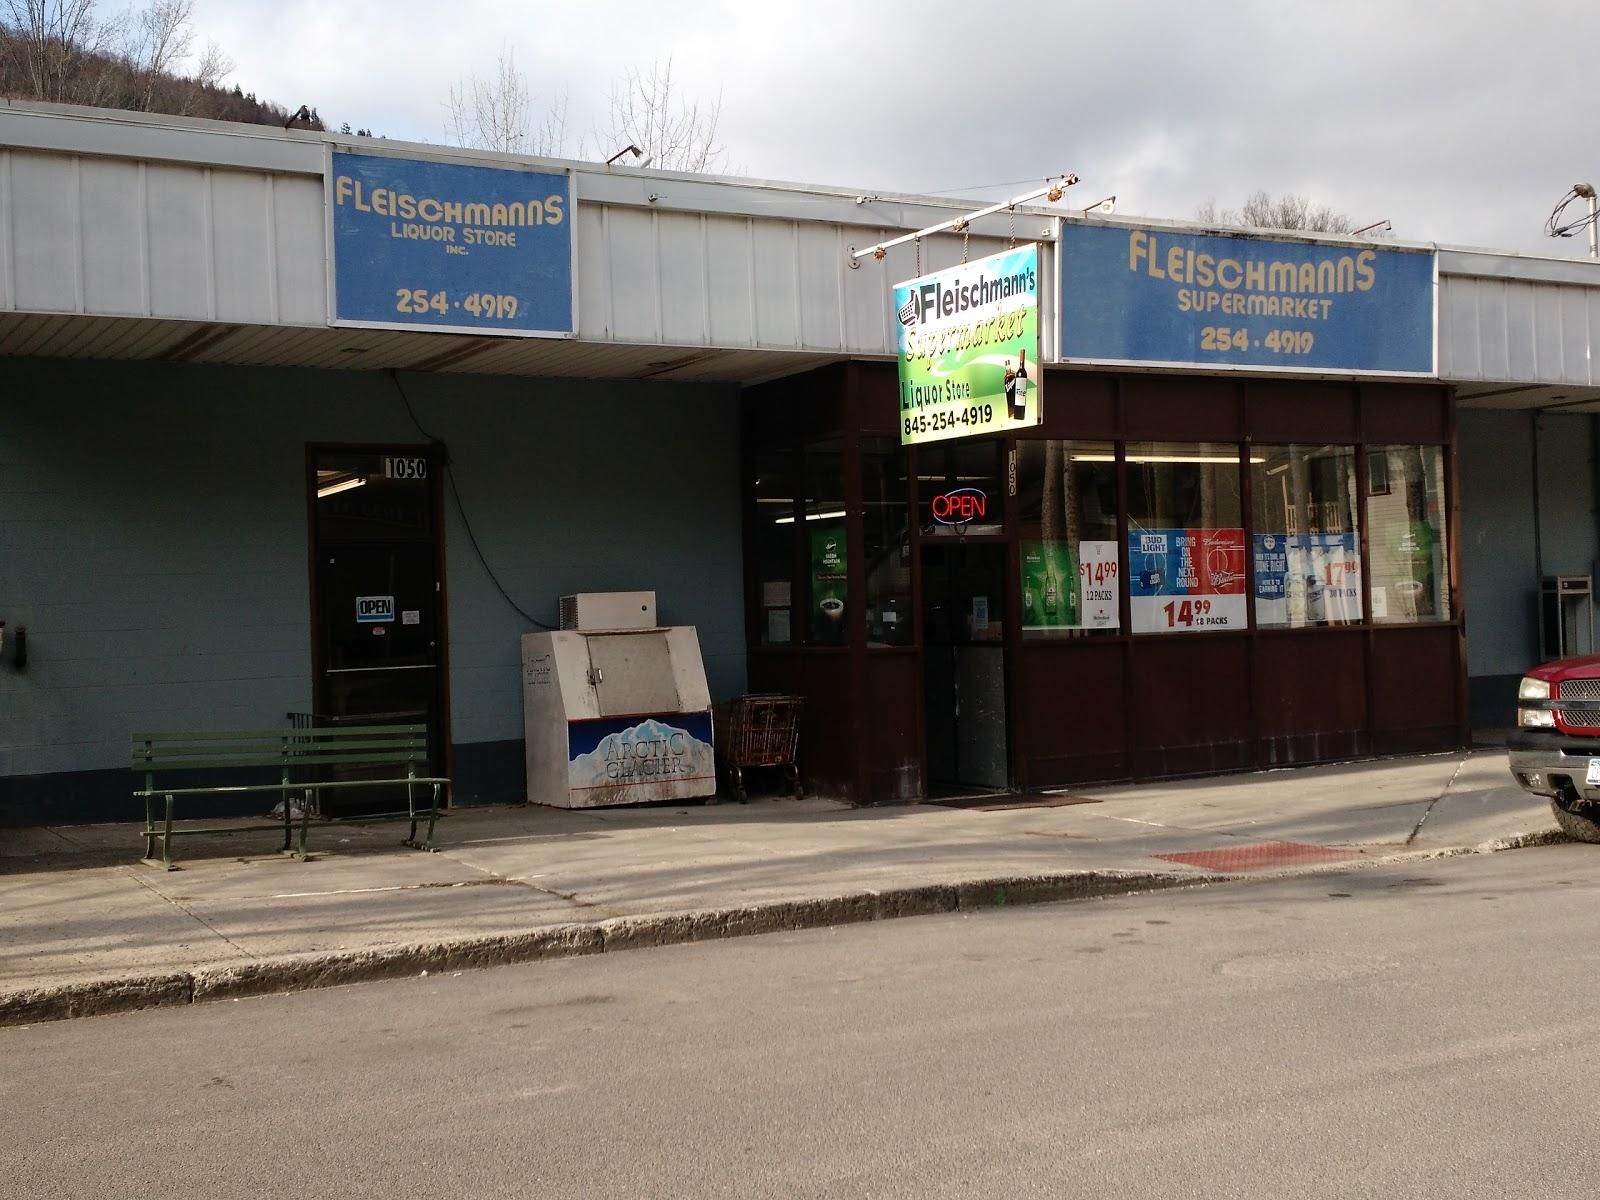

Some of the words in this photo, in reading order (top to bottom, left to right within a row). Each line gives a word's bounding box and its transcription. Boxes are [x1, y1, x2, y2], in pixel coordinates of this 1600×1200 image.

[336, 175, 564, 227] FLEISCHMANNS
[391, 222, 455, 242] LIQUOR
[463, 227, 516, 247] STORE
[446, 244, 469, 256] INC.
[1129, 230, 1377, 294] FLEISCHMANNS
[919, 266, 1036, 324] Fleischmann's
[1178, 288, 1333, 321] SUPERMARKET
[905, 302, 1028, 371] Supermarket
[901, 380, 943, 412] Liquor
[945, 379, 970, 402] Store
[904, 404, 993, 436] 845-254-4919
[388, 458, 427, 479] 1050
[932, 494, 987, 517] OPEN
[1142, 544, 1165, 552] LIGHT
[1145, 536, 1162, 544] BUD
[1176, 536, 1196, 547] BRING
[1180, 557, 1193, 567] THE
[1181, 547, 1191, 557] ON
[1176, 577, 1199, 588] ROUND
[1178, 567, 1195, 577] NEXT
[1086, 591, 1094, 600] 12
[1095, 590, 1112, 601] PACKS
[360, 600, 391, 614] OPEN
[1196, 618, 1204, 626] 18
[1206, 617, 1228, 625] PACKS
[604, 733, 685, 762] ARCTIC
[606, 756, 686, 779] GLACIER
